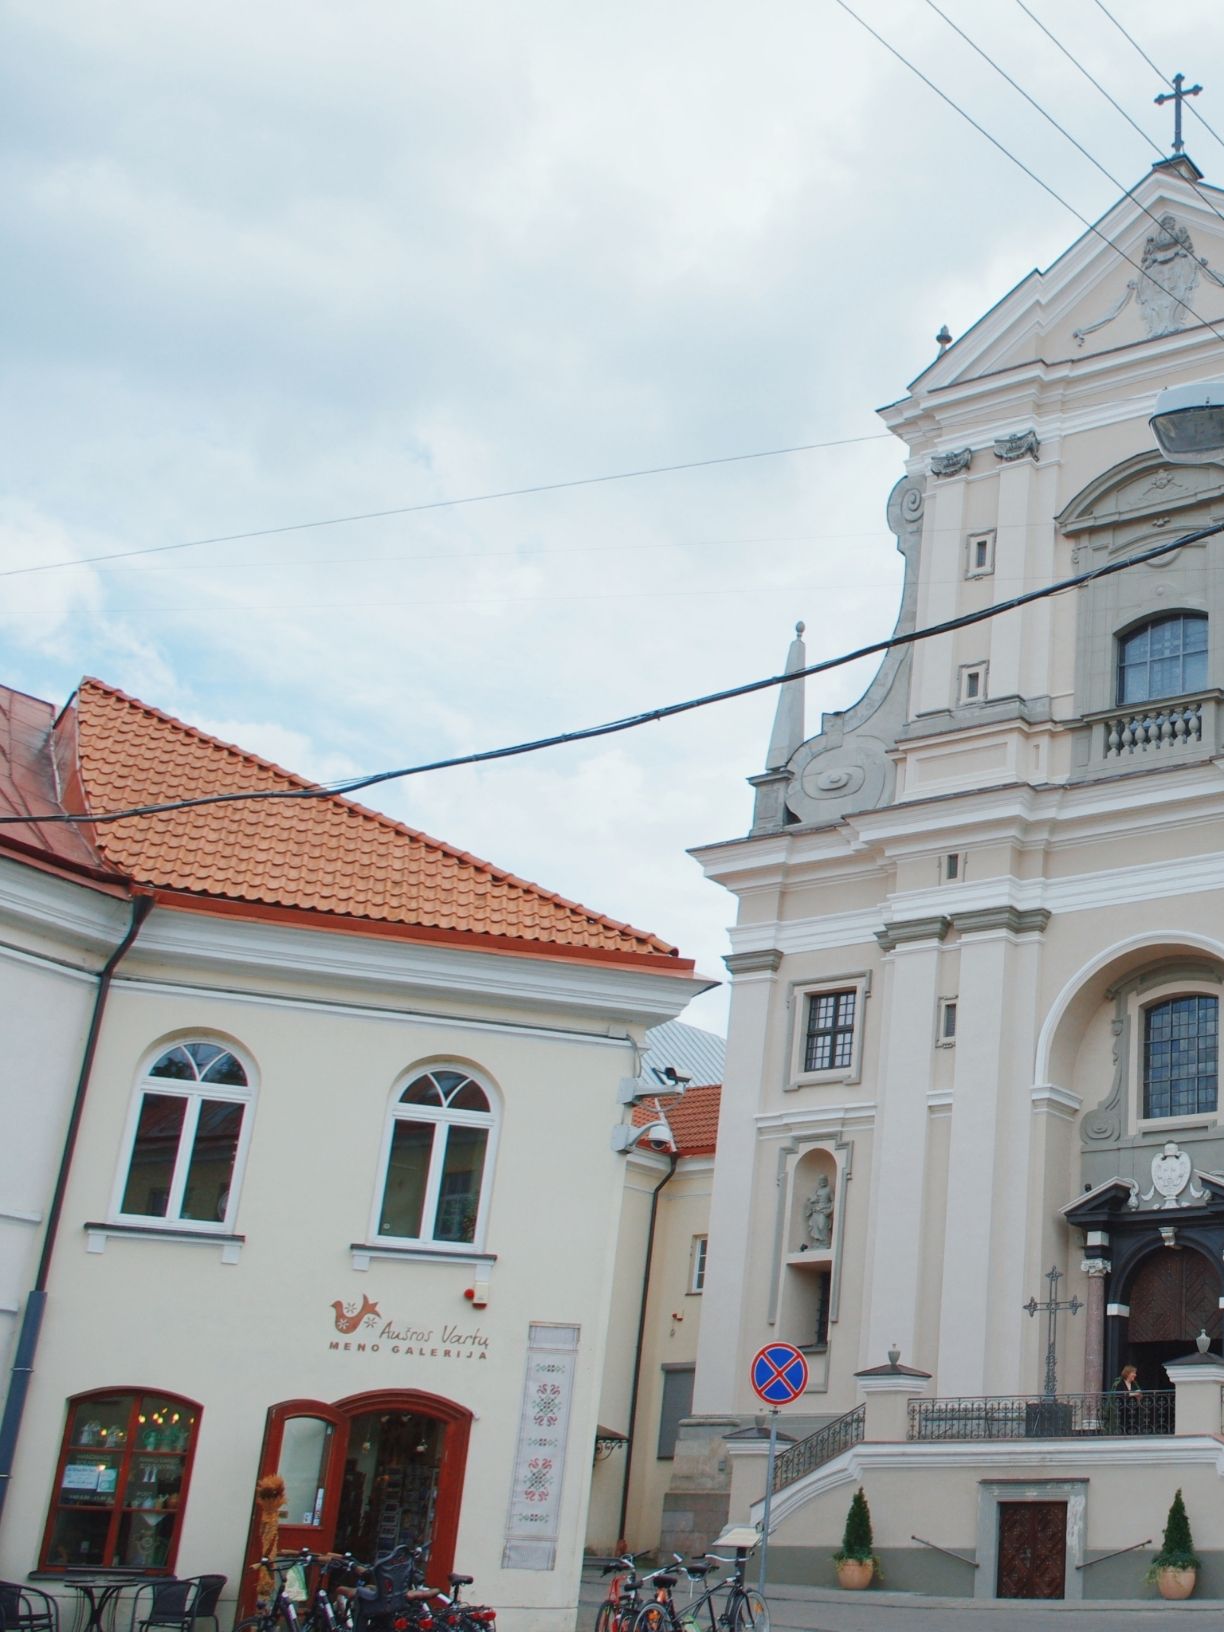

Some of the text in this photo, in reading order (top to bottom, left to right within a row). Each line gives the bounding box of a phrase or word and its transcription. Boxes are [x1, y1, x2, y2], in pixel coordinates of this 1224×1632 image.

[379, 1320, 489, 1350] Aušros Vartų
[329, 1341, 487, 1360] MENO GALERIJA
